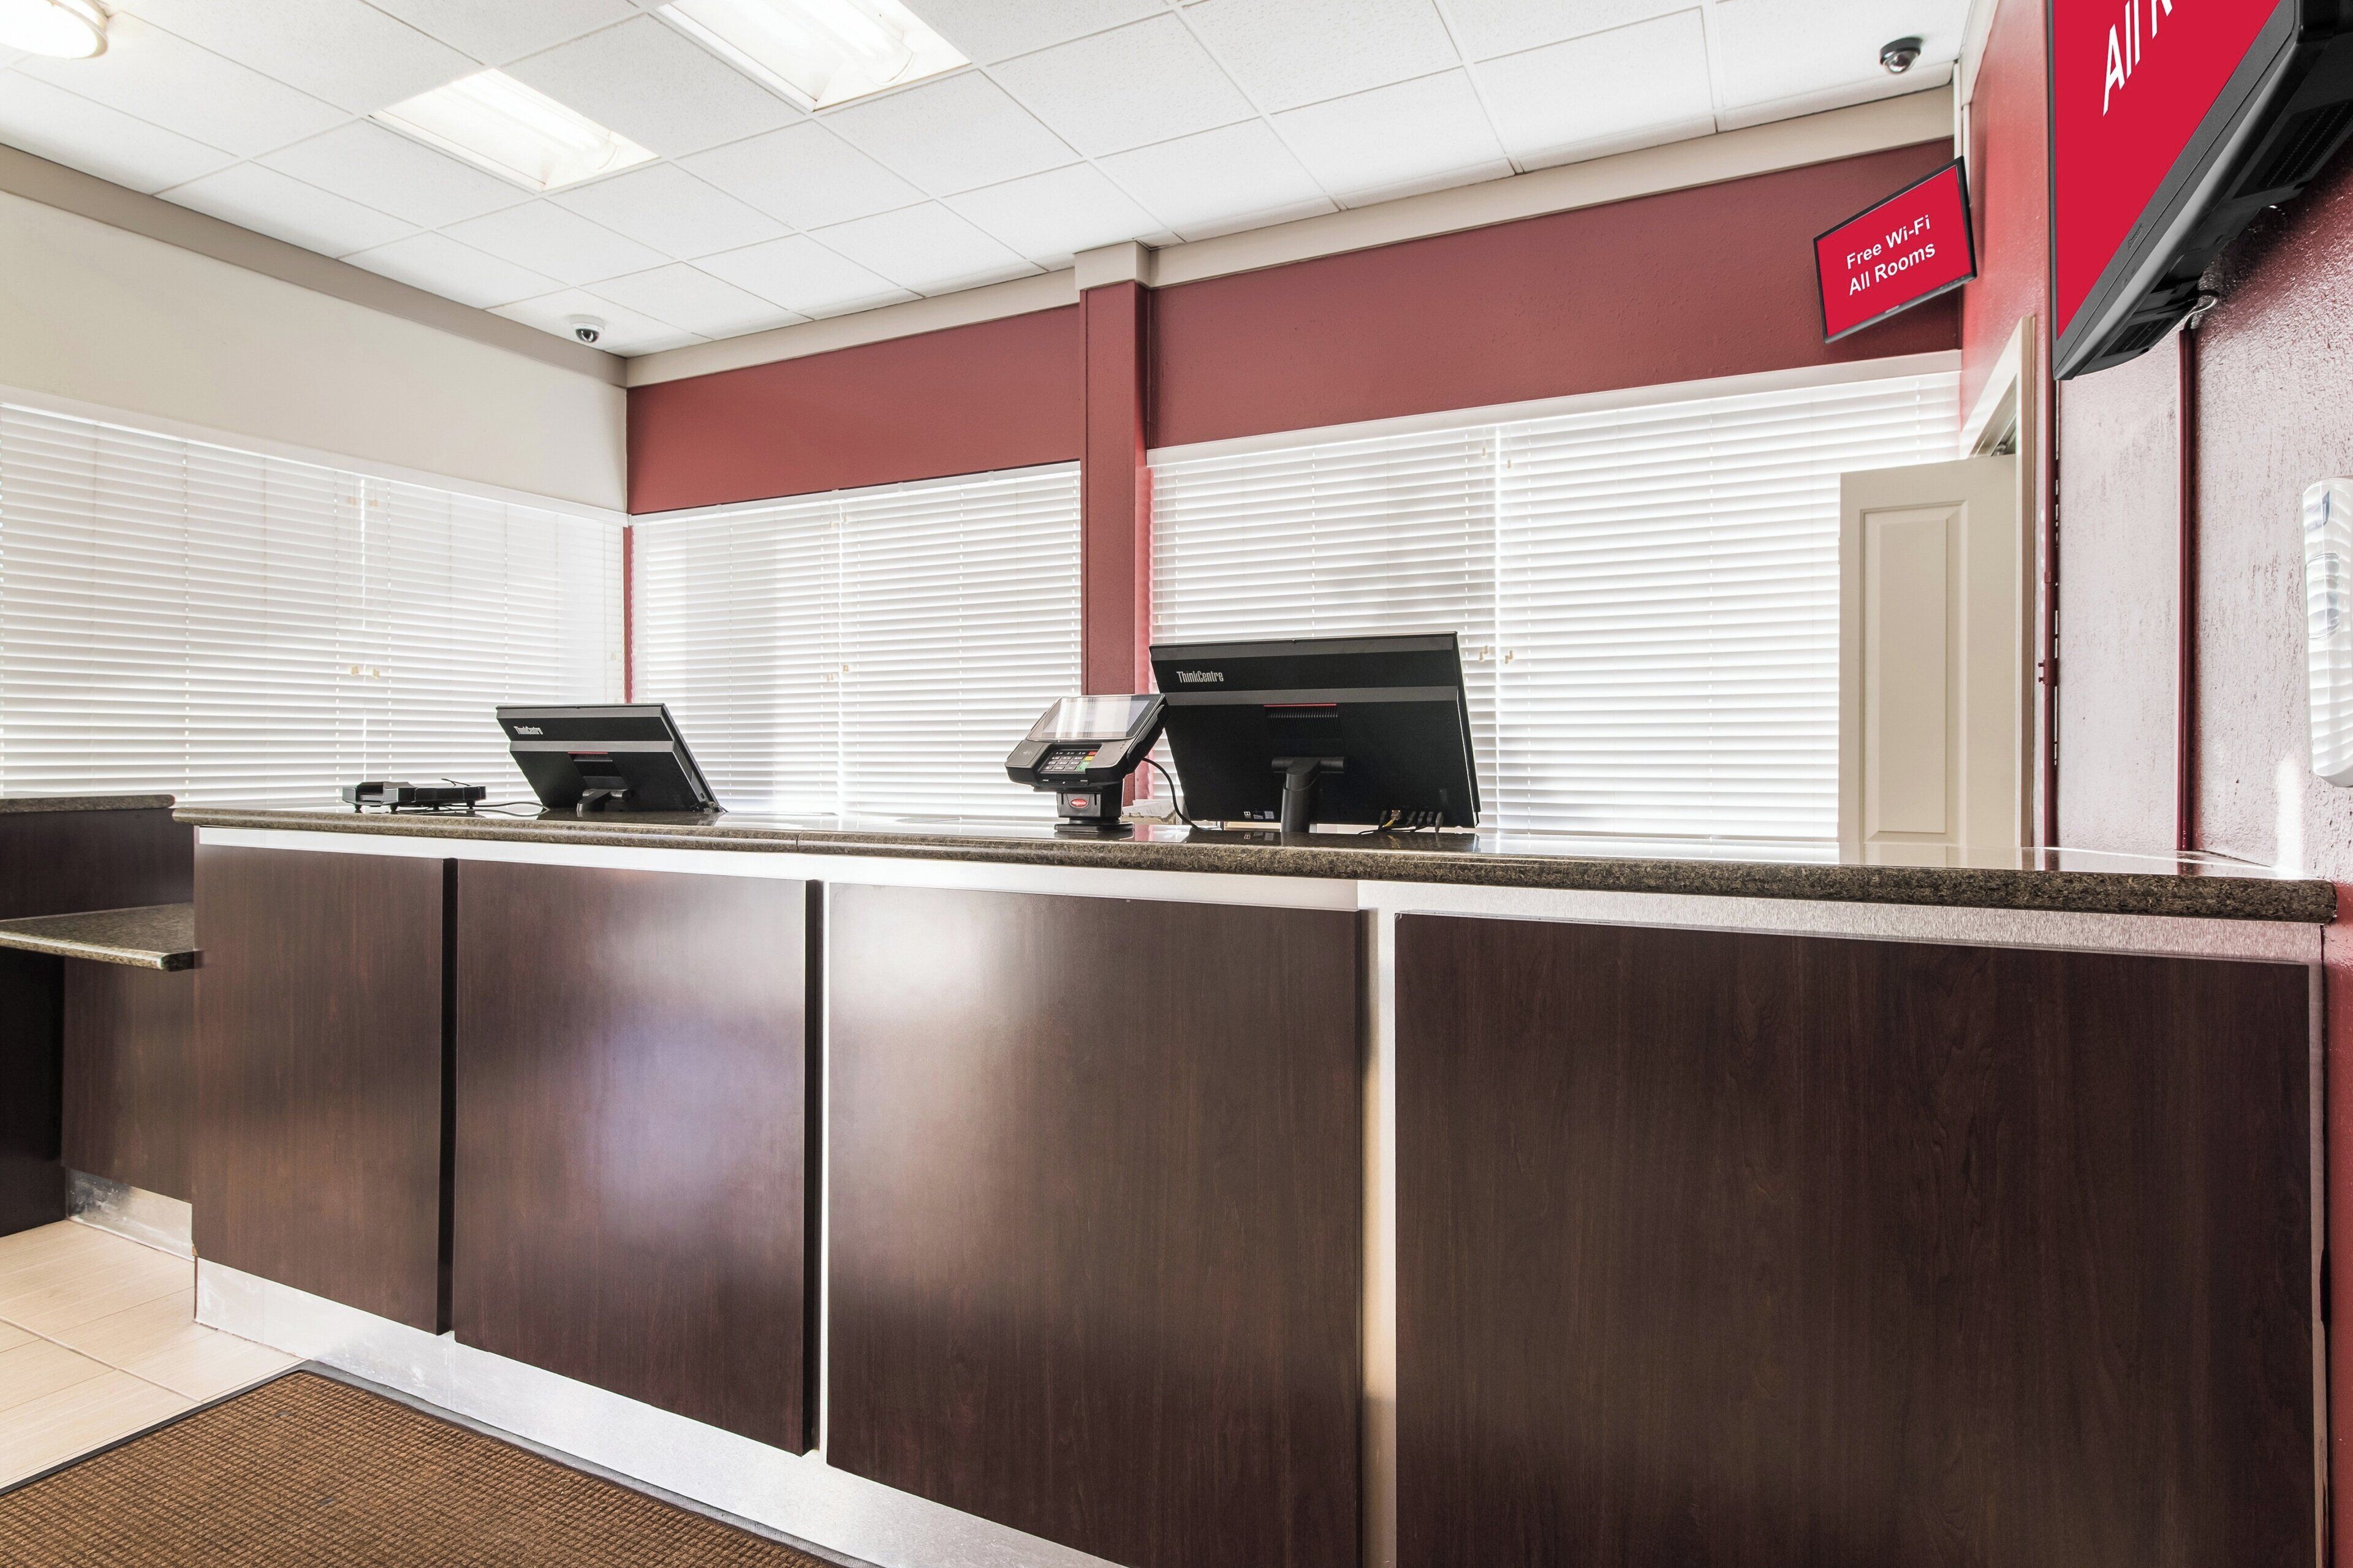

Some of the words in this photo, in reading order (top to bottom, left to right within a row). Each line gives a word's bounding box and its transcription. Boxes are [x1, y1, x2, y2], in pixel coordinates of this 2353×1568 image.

[2102, 0, 2140, 117] All
[1846, 243, 1882, 270] Free
[1885, 214, 1930, 249] Wi-Fi
[1849, 271, 1870, 296] All
[1874, 243, 1936, 283] Rooms
[1176, 670, 1224, 683] ThinkCentre
